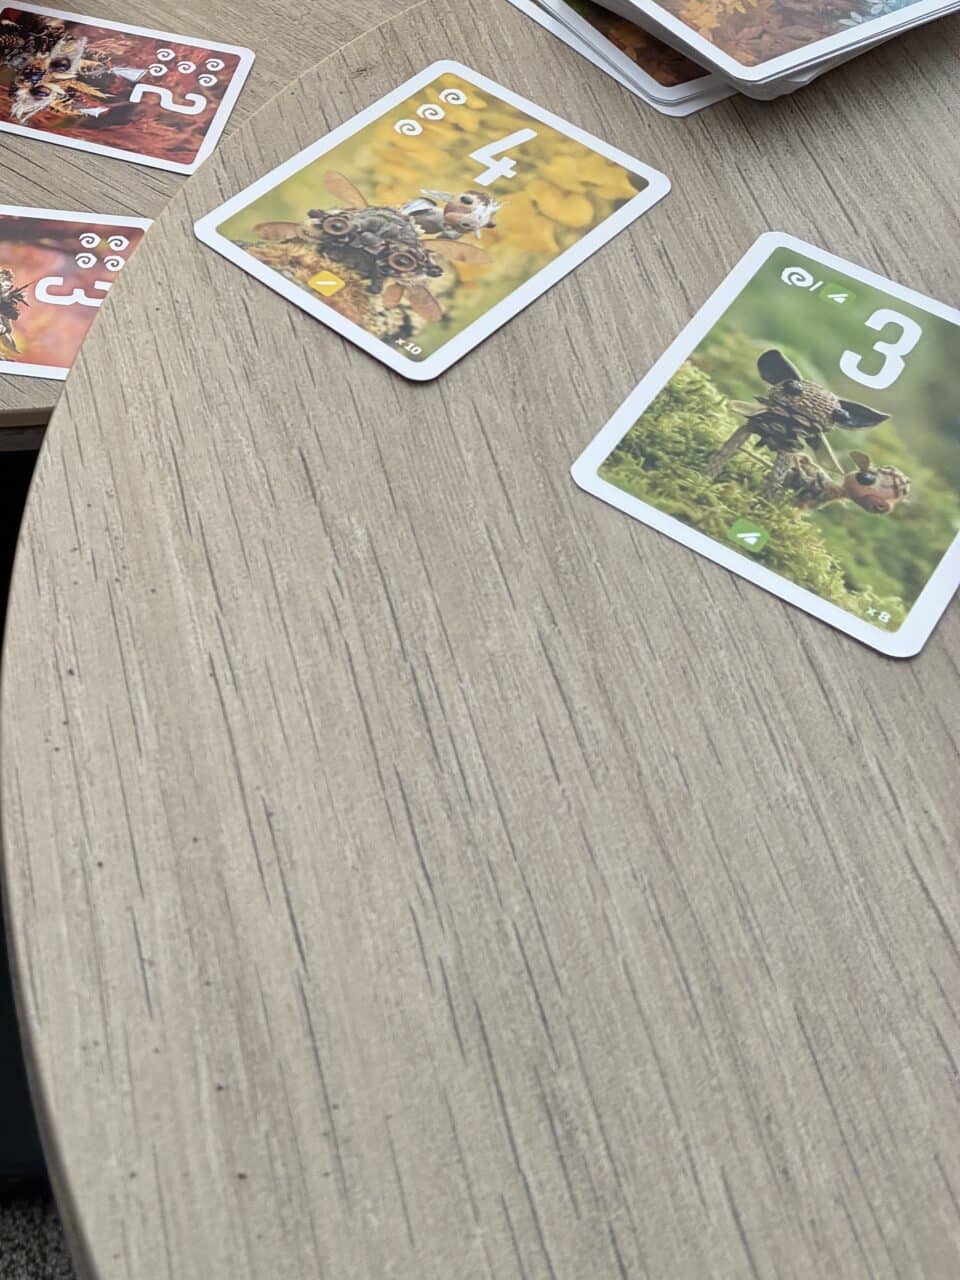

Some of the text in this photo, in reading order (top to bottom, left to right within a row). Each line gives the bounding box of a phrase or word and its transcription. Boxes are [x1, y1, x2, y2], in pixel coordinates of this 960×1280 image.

[130, 84, 208, 115] 2
[469, 127, 538, 187] 4
[35, 276, 113, 308] 3
[840, 308, 922, 390] 3
